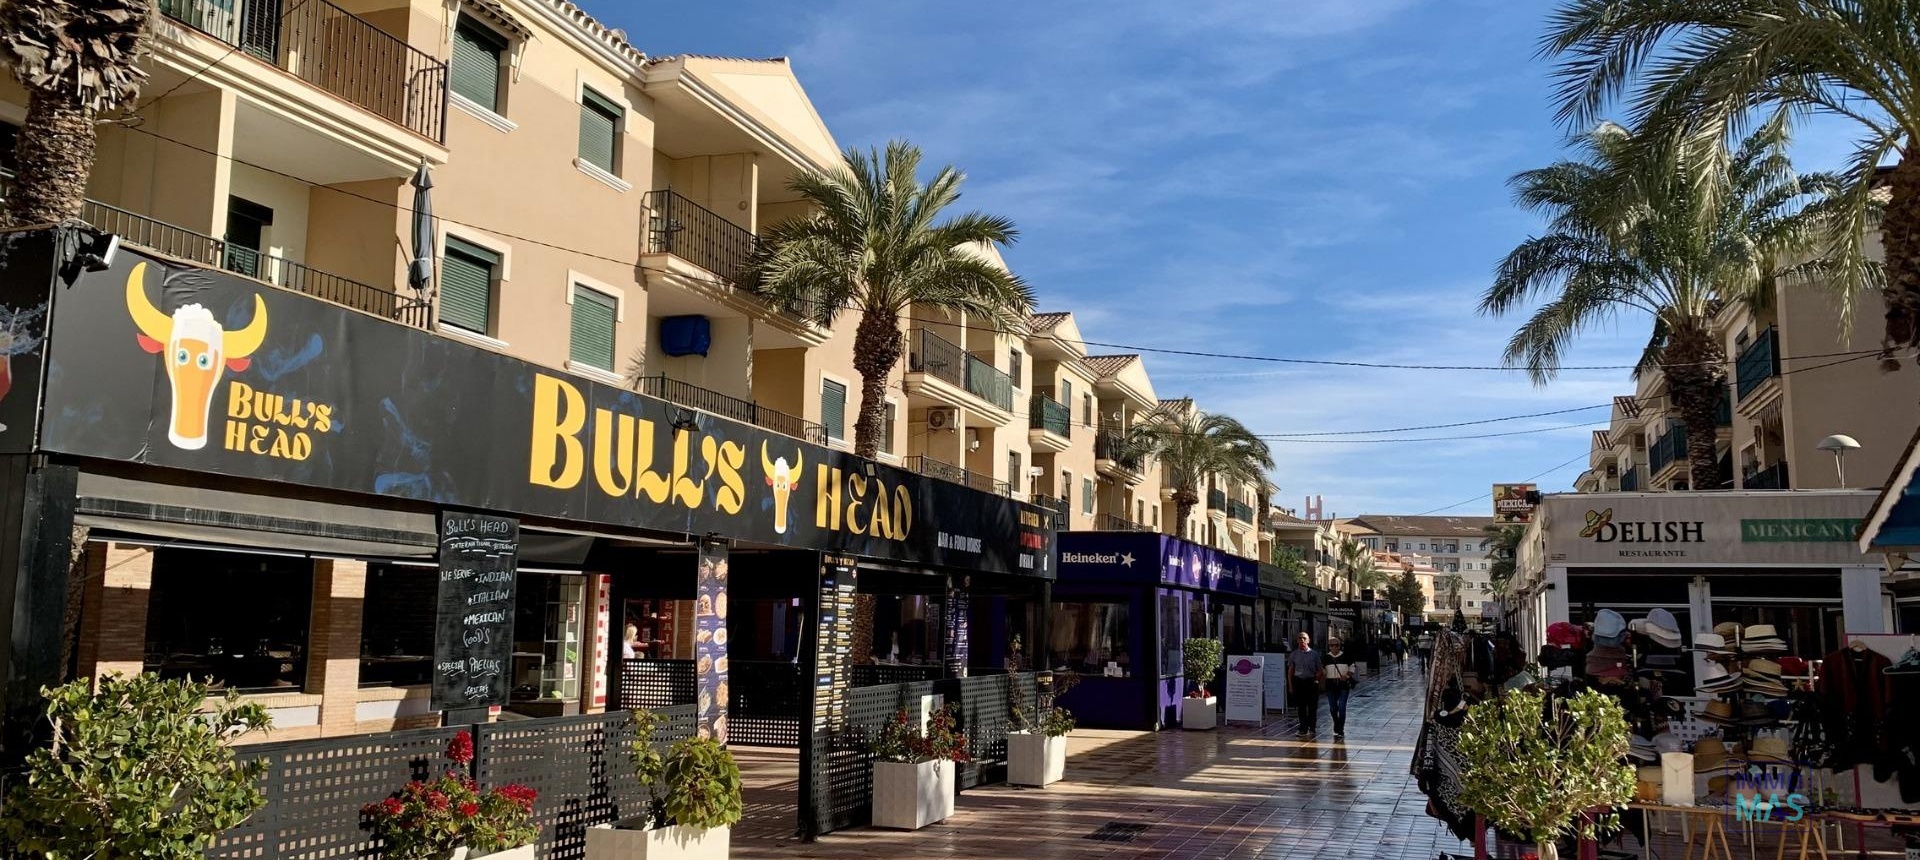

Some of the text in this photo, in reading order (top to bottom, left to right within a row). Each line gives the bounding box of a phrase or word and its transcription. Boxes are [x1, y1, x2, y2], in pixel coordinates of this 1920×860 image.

[228, 381, 332, 433] BULL'S
[225, 420, 312, 461] HEAD
[530, 373, 912, 542] BULL'S HEAD
[480, 520, 509, 534] HEAD
[1595, 521, 1706, 543] DELISH
[1747, 524, 1845, 537] MEXICAN
[1062, 552, 1117, 564] Heineken
[441, 571, 452, 581] WE
[472, 589, 510, 605] ITALIAN
[468, 609, 506, 625] MEXICAN
